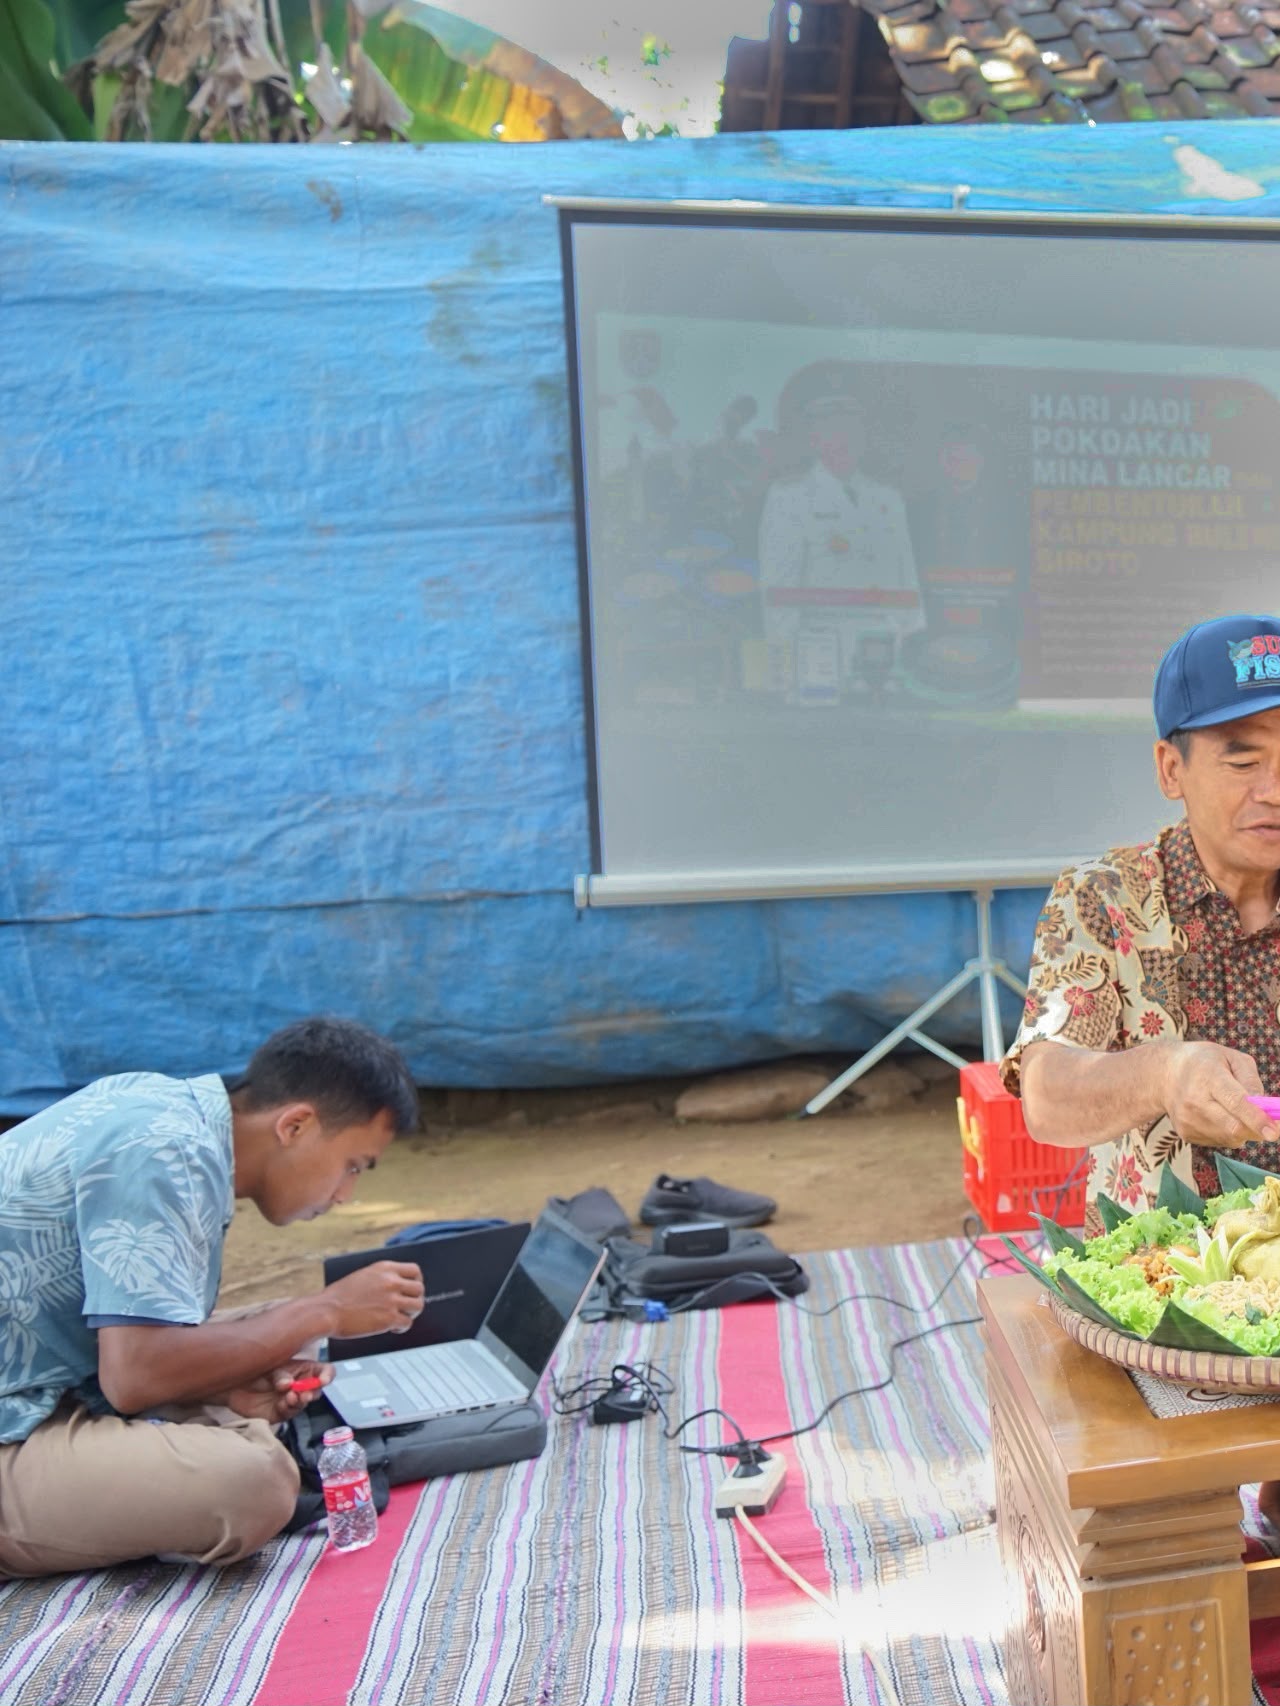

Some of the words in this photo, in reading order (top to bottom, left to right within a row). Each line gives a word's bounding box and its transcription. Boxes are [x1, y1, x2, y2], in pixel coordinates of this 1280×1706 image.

[1031, 394, 1110, 422] HARI
[1120, 394, 1192, 426] JADI
[1032, 425, 1212, 458] POKDAKAN
[1033, 458, 1109, 485] MINA
[1117, 460, 1232, 489] LANCAR
